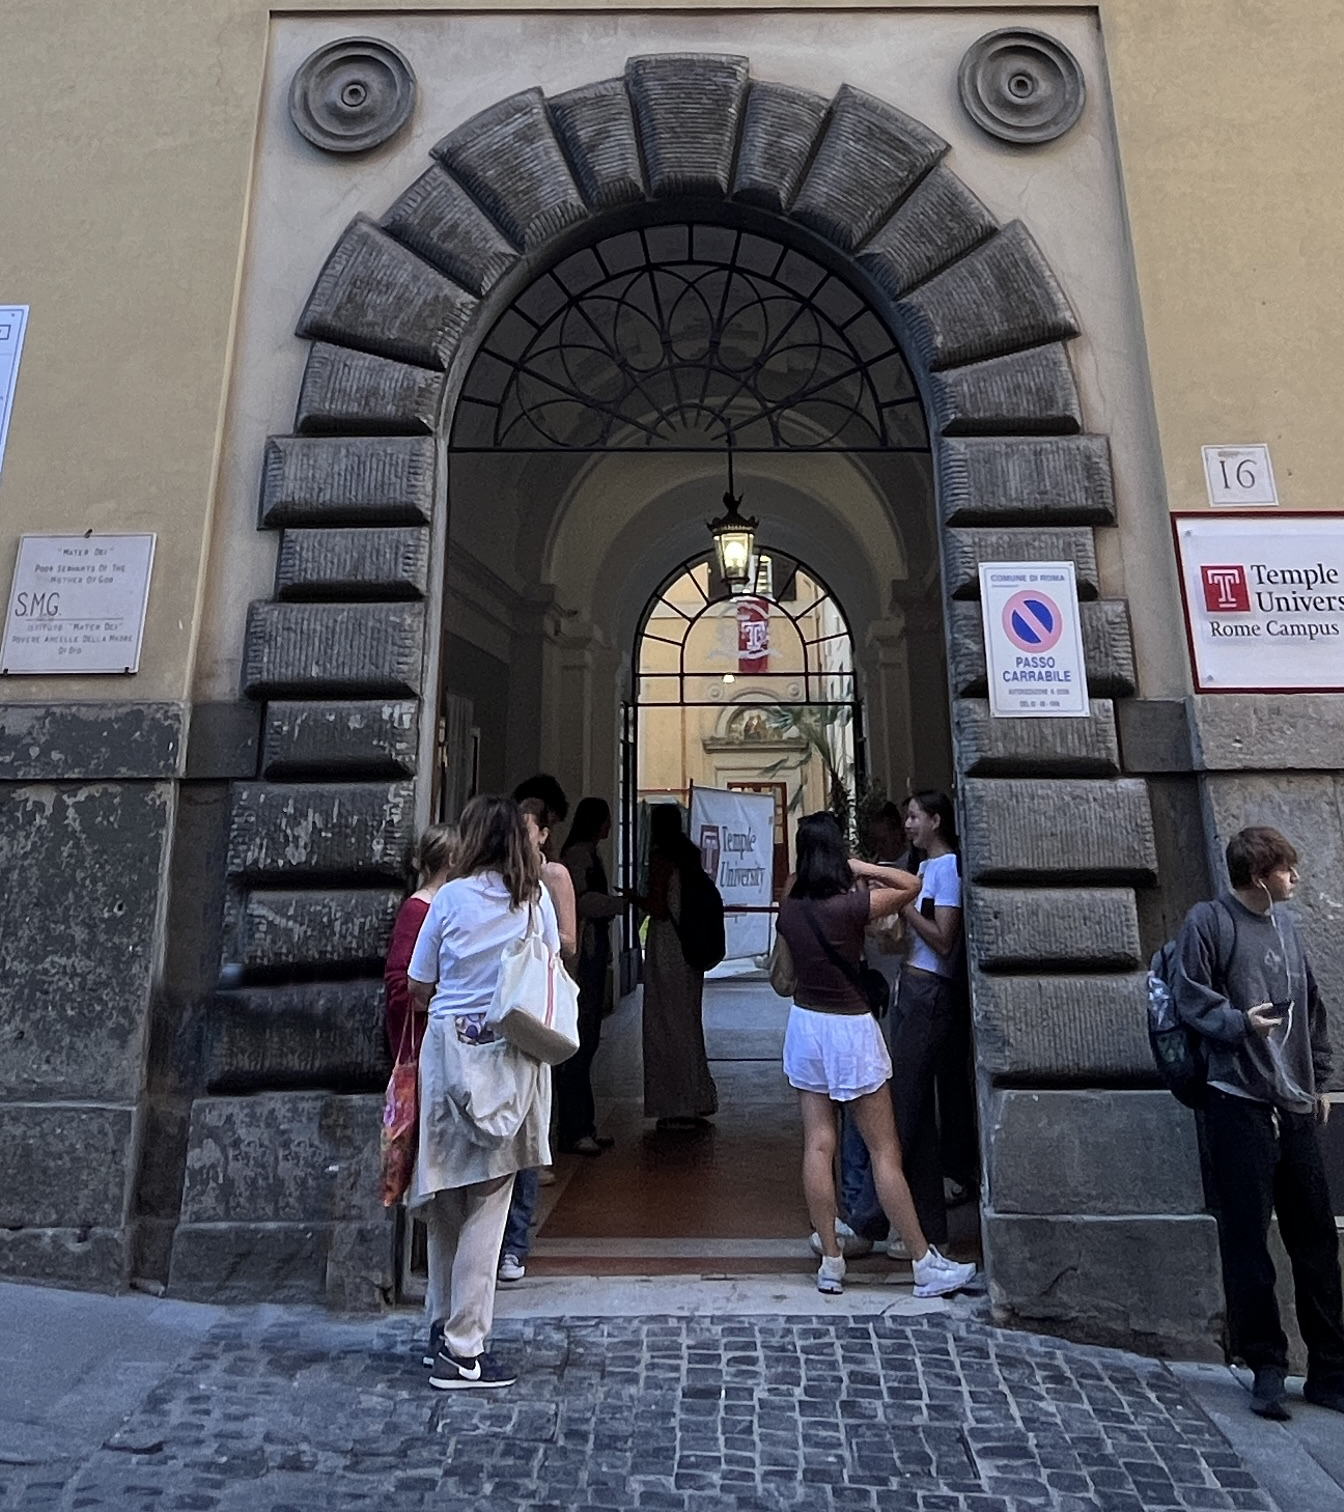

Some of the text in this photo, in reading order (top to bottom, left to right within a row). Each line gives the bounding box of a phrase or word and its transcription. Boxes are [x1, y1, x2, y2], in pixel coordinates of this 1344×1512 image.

[1220, 459, 1259, 489] 16
[991, 574, 1065, 582] COMUNE DI ROMA
[1251, 563, 1339, 590] Temple
[1210, 620, 1340, 641] Rome Campus
[1016, 656, 1055, 669] PASSO
[1002, 670, 1071, 683] CARRABILE
[722, 826, 756, 860] Temple
[720, 861, 766, 893] University
